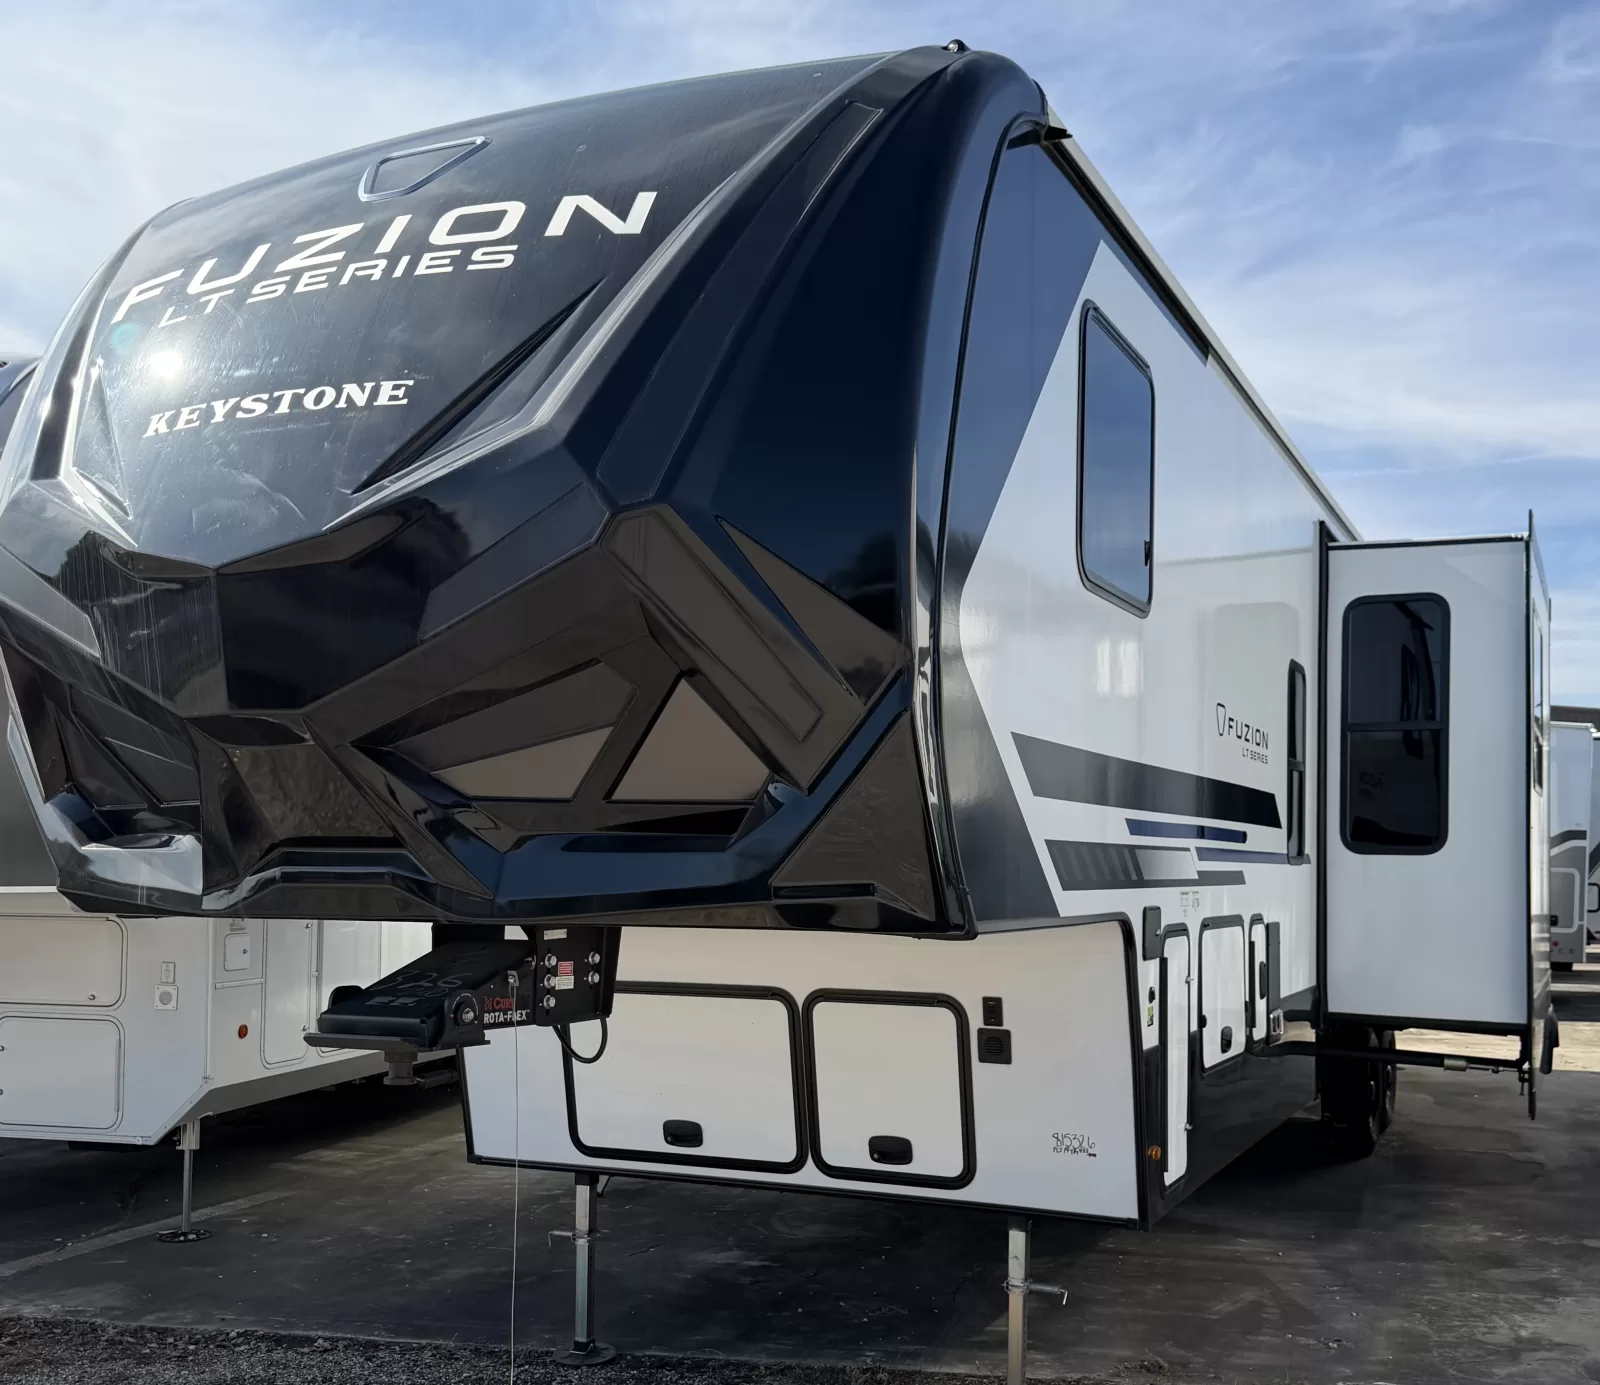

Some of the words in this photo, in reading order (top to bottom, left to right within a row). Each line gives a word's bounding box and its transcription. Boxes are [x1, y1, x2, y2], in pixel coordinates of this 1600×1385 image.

[111, 191, 657, 324] FUZION
[157, 287, 239, 328] LT
[246, 243, 519, 305] SERIES
[142, 379, 415, 439] KEYSTONE
[1227, 716, 1269, 751] FUZION
[1242, 747, 1249, 758] LT
[1250, 749, 1268, 765] SERIES
[1051, 1132, 1096, 1150] 815326
